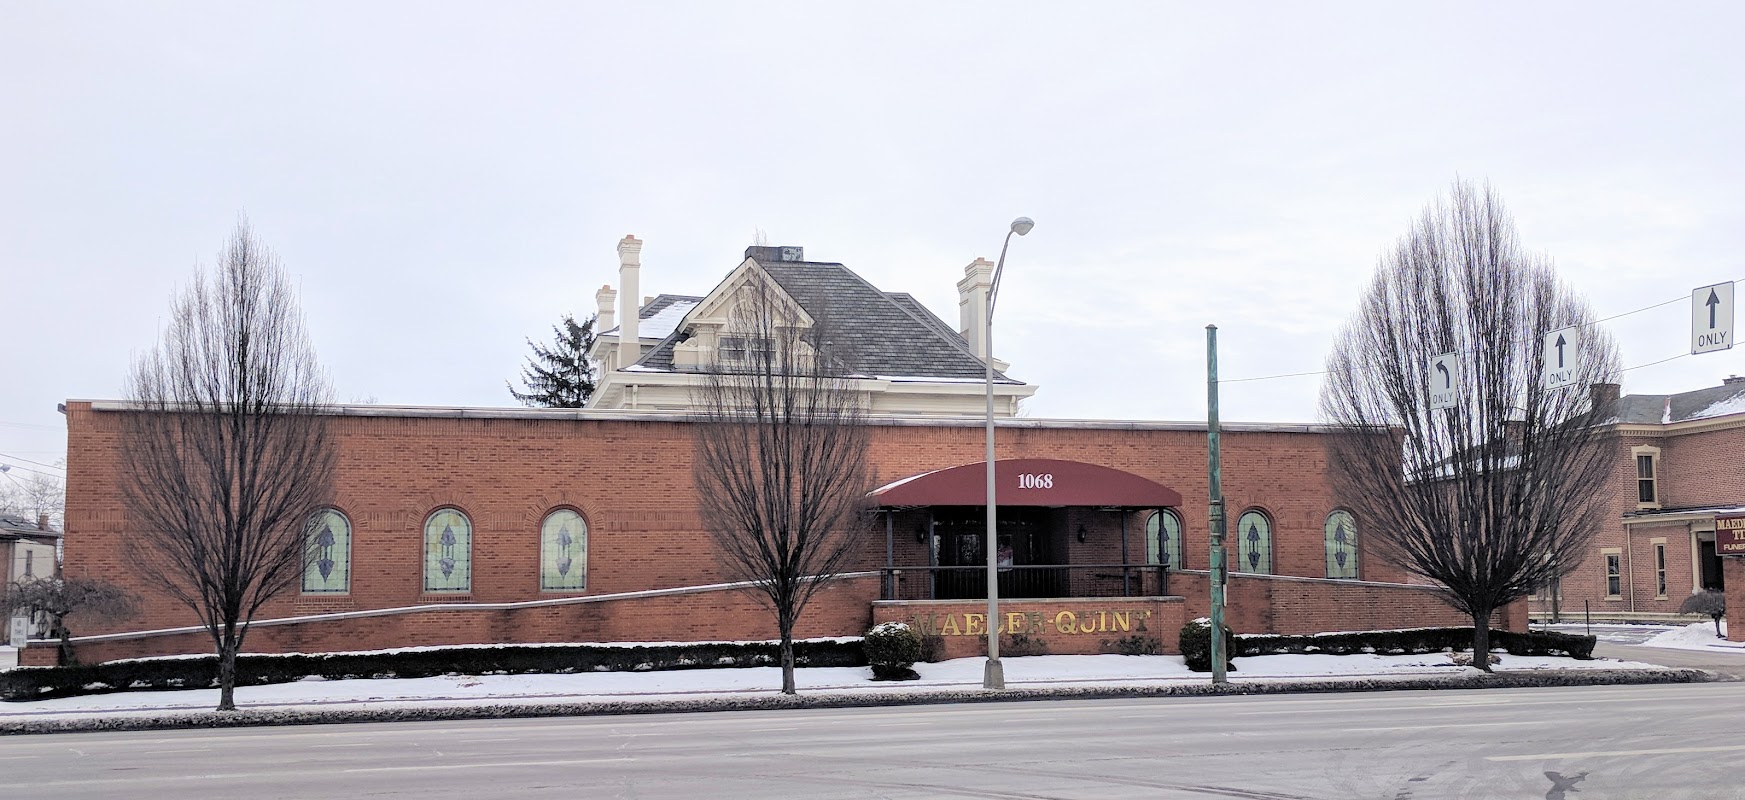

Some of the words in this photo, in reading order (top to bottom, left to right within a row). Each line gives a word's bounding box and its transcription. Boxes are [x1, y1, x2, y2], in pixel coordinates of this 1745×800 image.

[1698, 330, 1727, 347] ONLY
[1549, 368, 1573, 385] ONLY
[1433, 392, 1453, 405] ONLY
[1017, 473, 1053, 489] 1068
